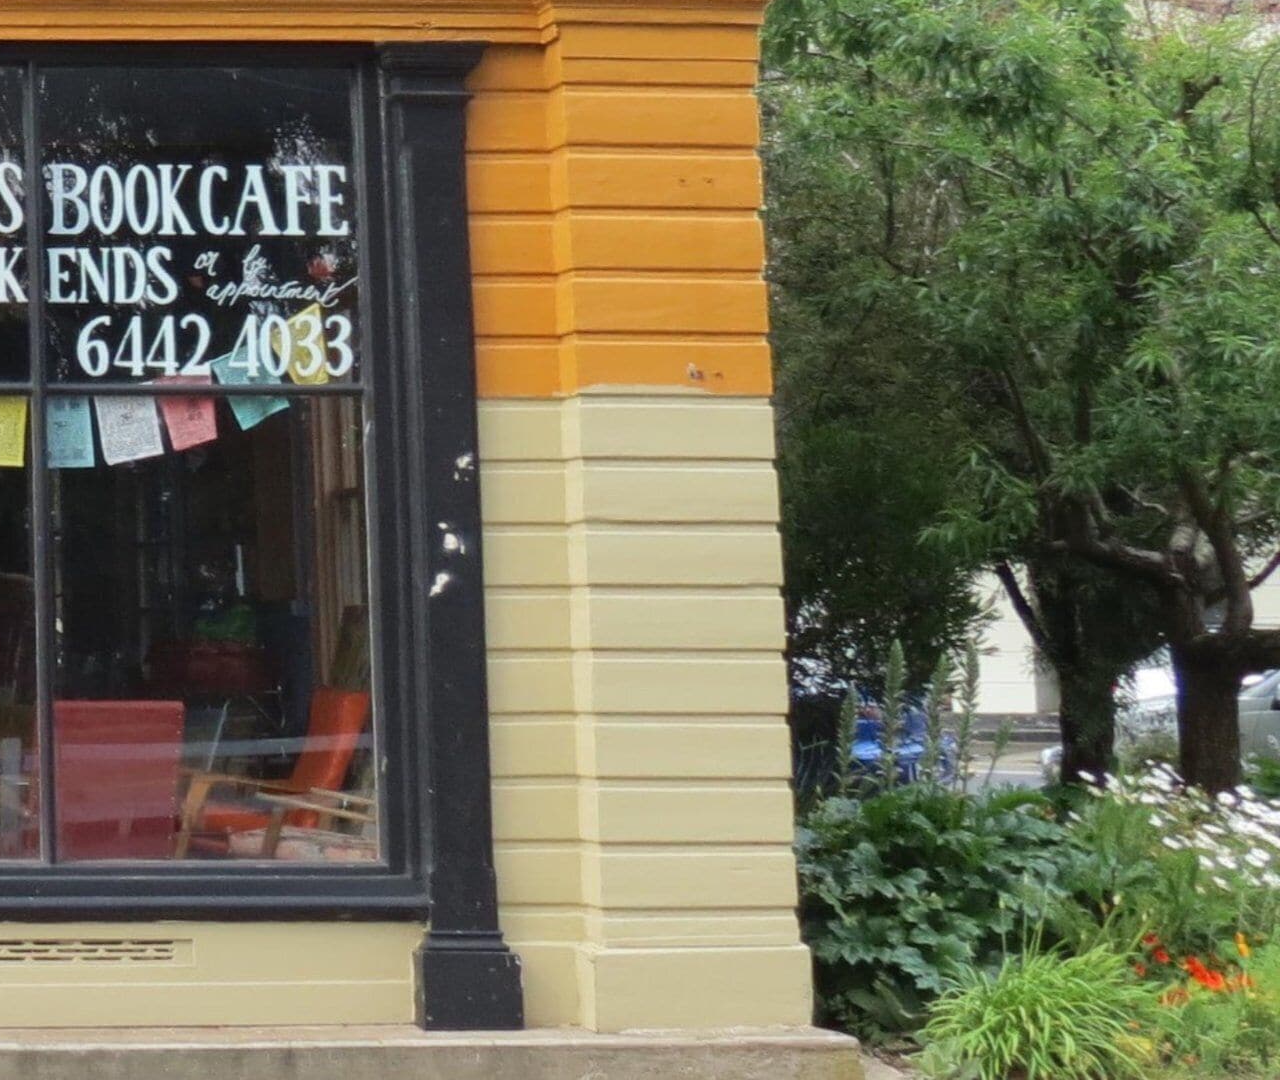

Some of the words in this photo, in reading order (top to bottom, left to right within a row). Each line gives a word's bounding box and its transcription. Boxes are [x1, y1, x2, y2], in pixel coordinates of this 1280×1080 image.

[193, 251, 220, 276] or
[243, 244, 268, 282] by
[206, 277, 359, 308] appointment
[76, 315, 211, 378] 6442
[228, 315, 354, 378] 4033
